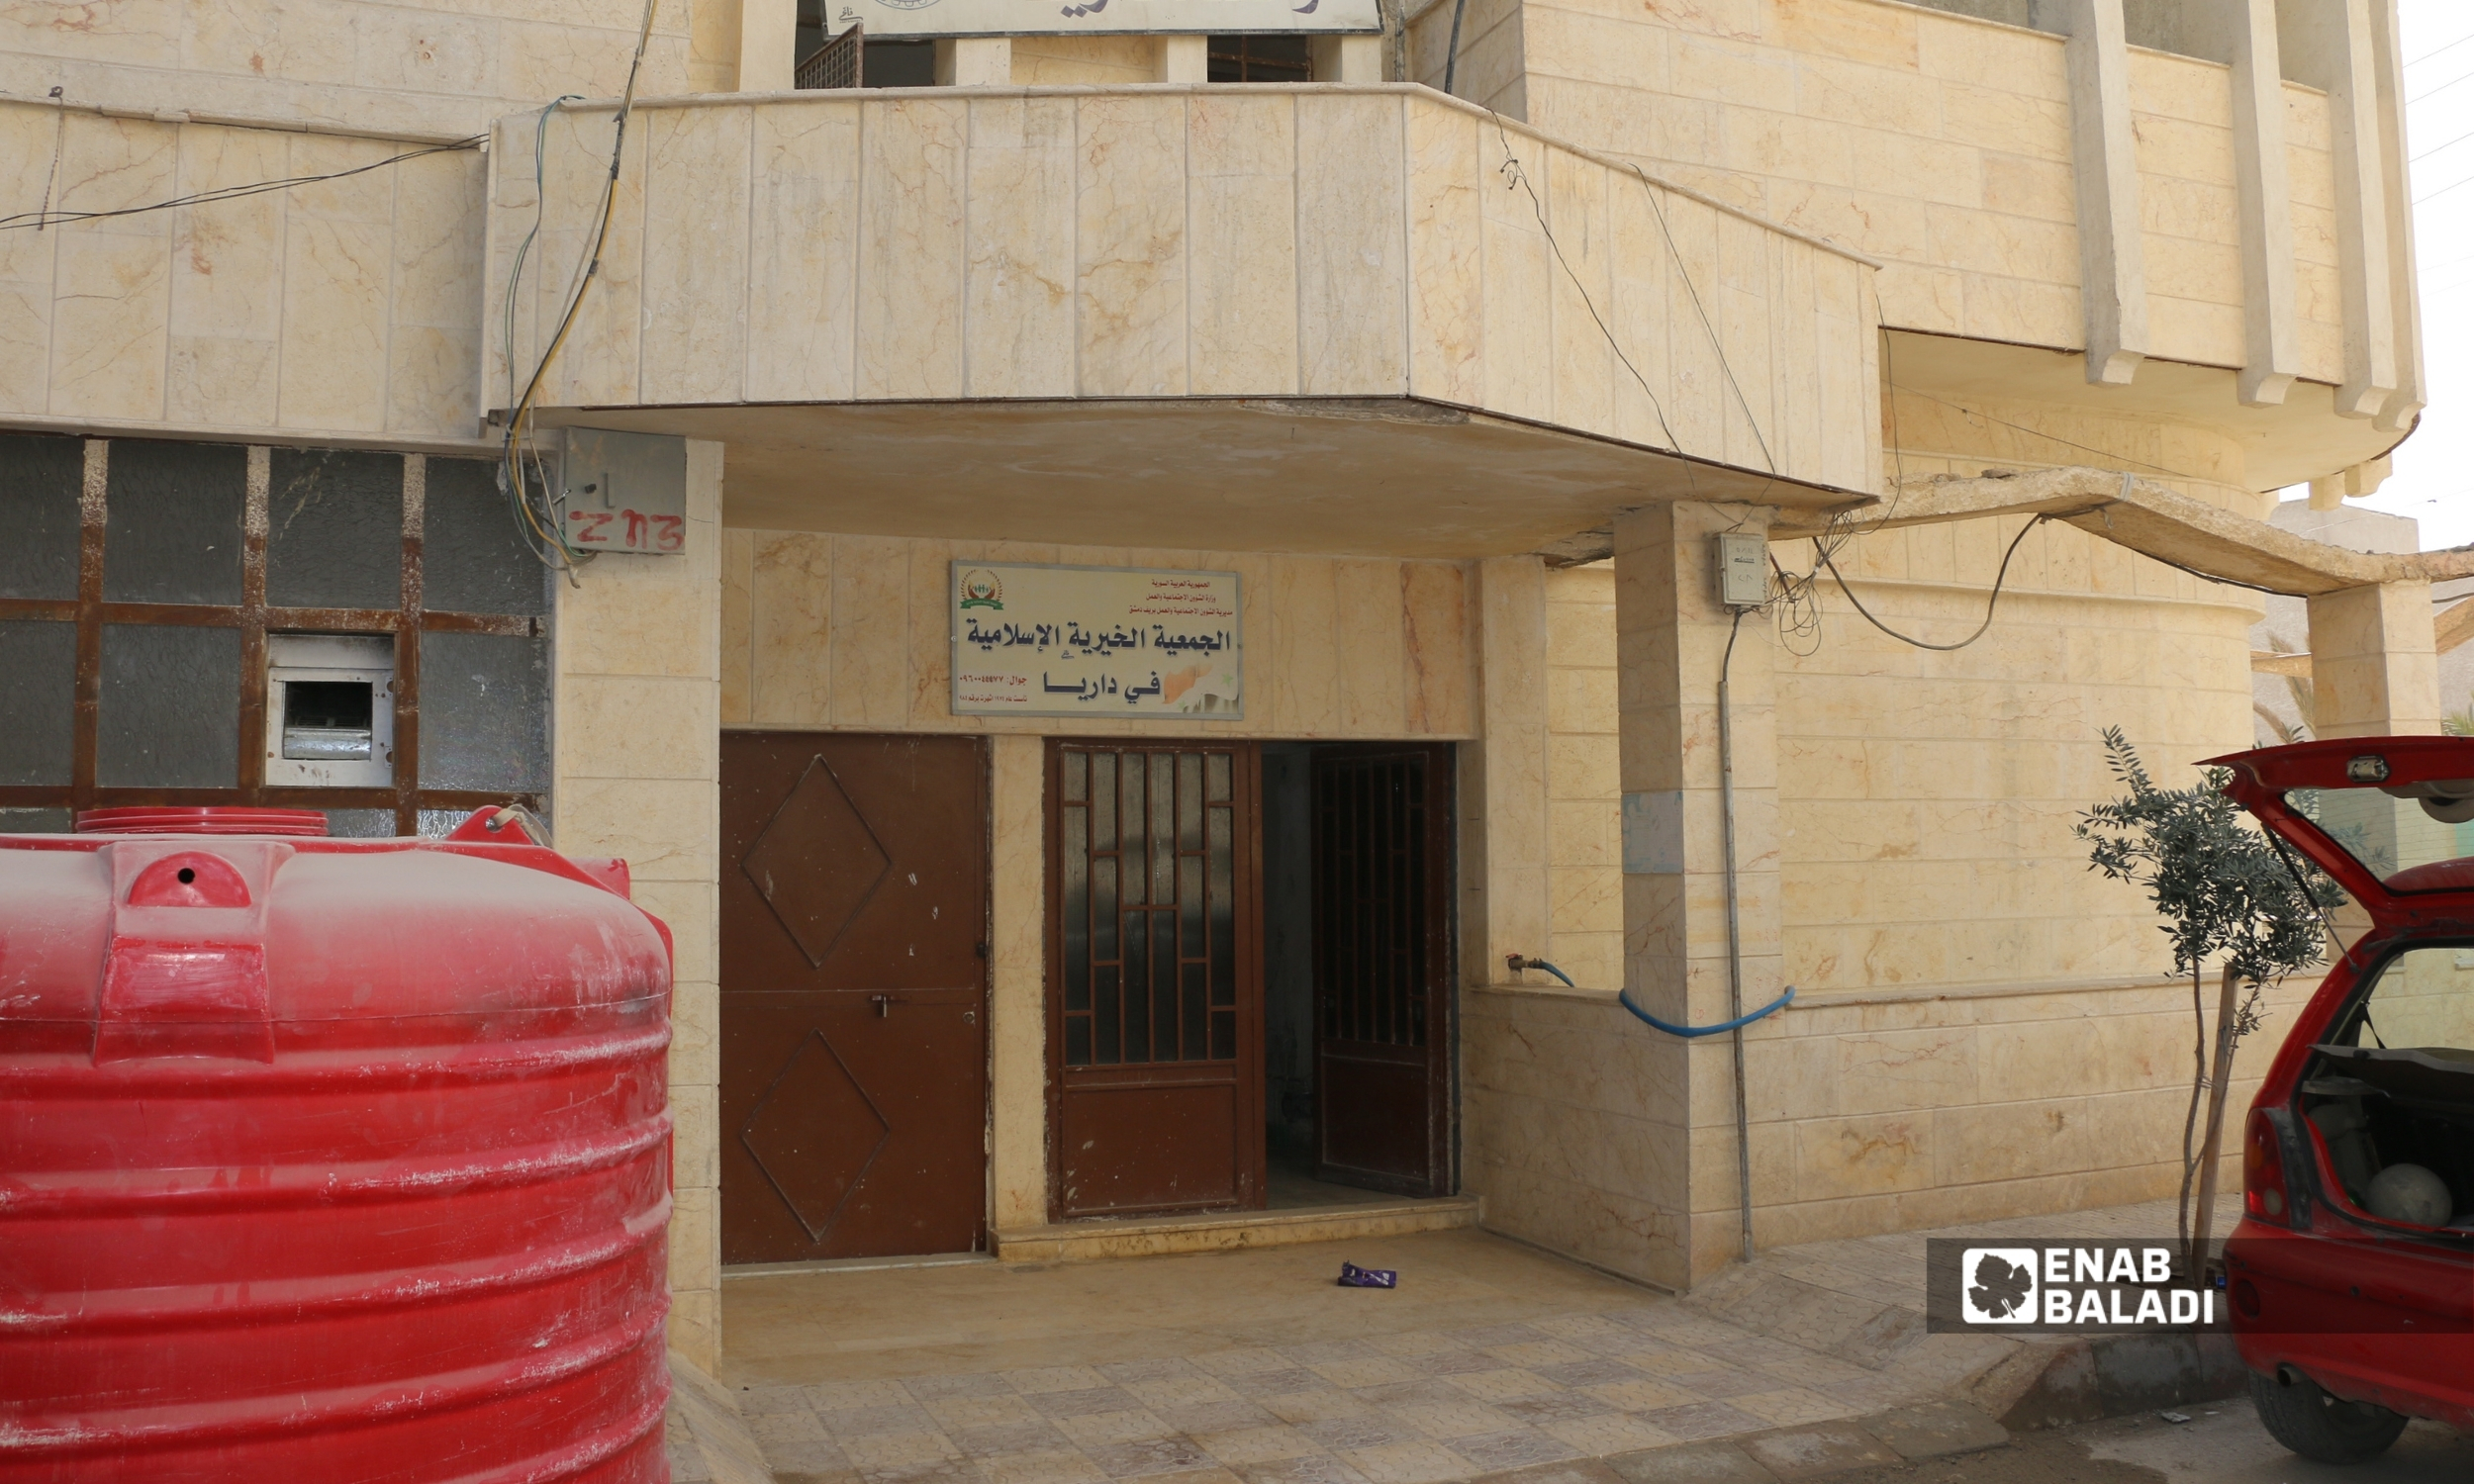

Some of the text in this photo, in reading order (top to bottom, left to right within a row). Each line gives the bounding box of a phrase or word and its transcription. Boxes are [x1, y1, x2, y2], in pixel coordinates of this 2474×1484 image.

[1151, 579, 1210, 589] الجمهورية العربية السورية
[1216, 608, 1233, 617] مديرية
[966, 617, 1231, 656] الجمعية الخيرية الإسلامية
[1043, 671, 1161, 704] في داريا
